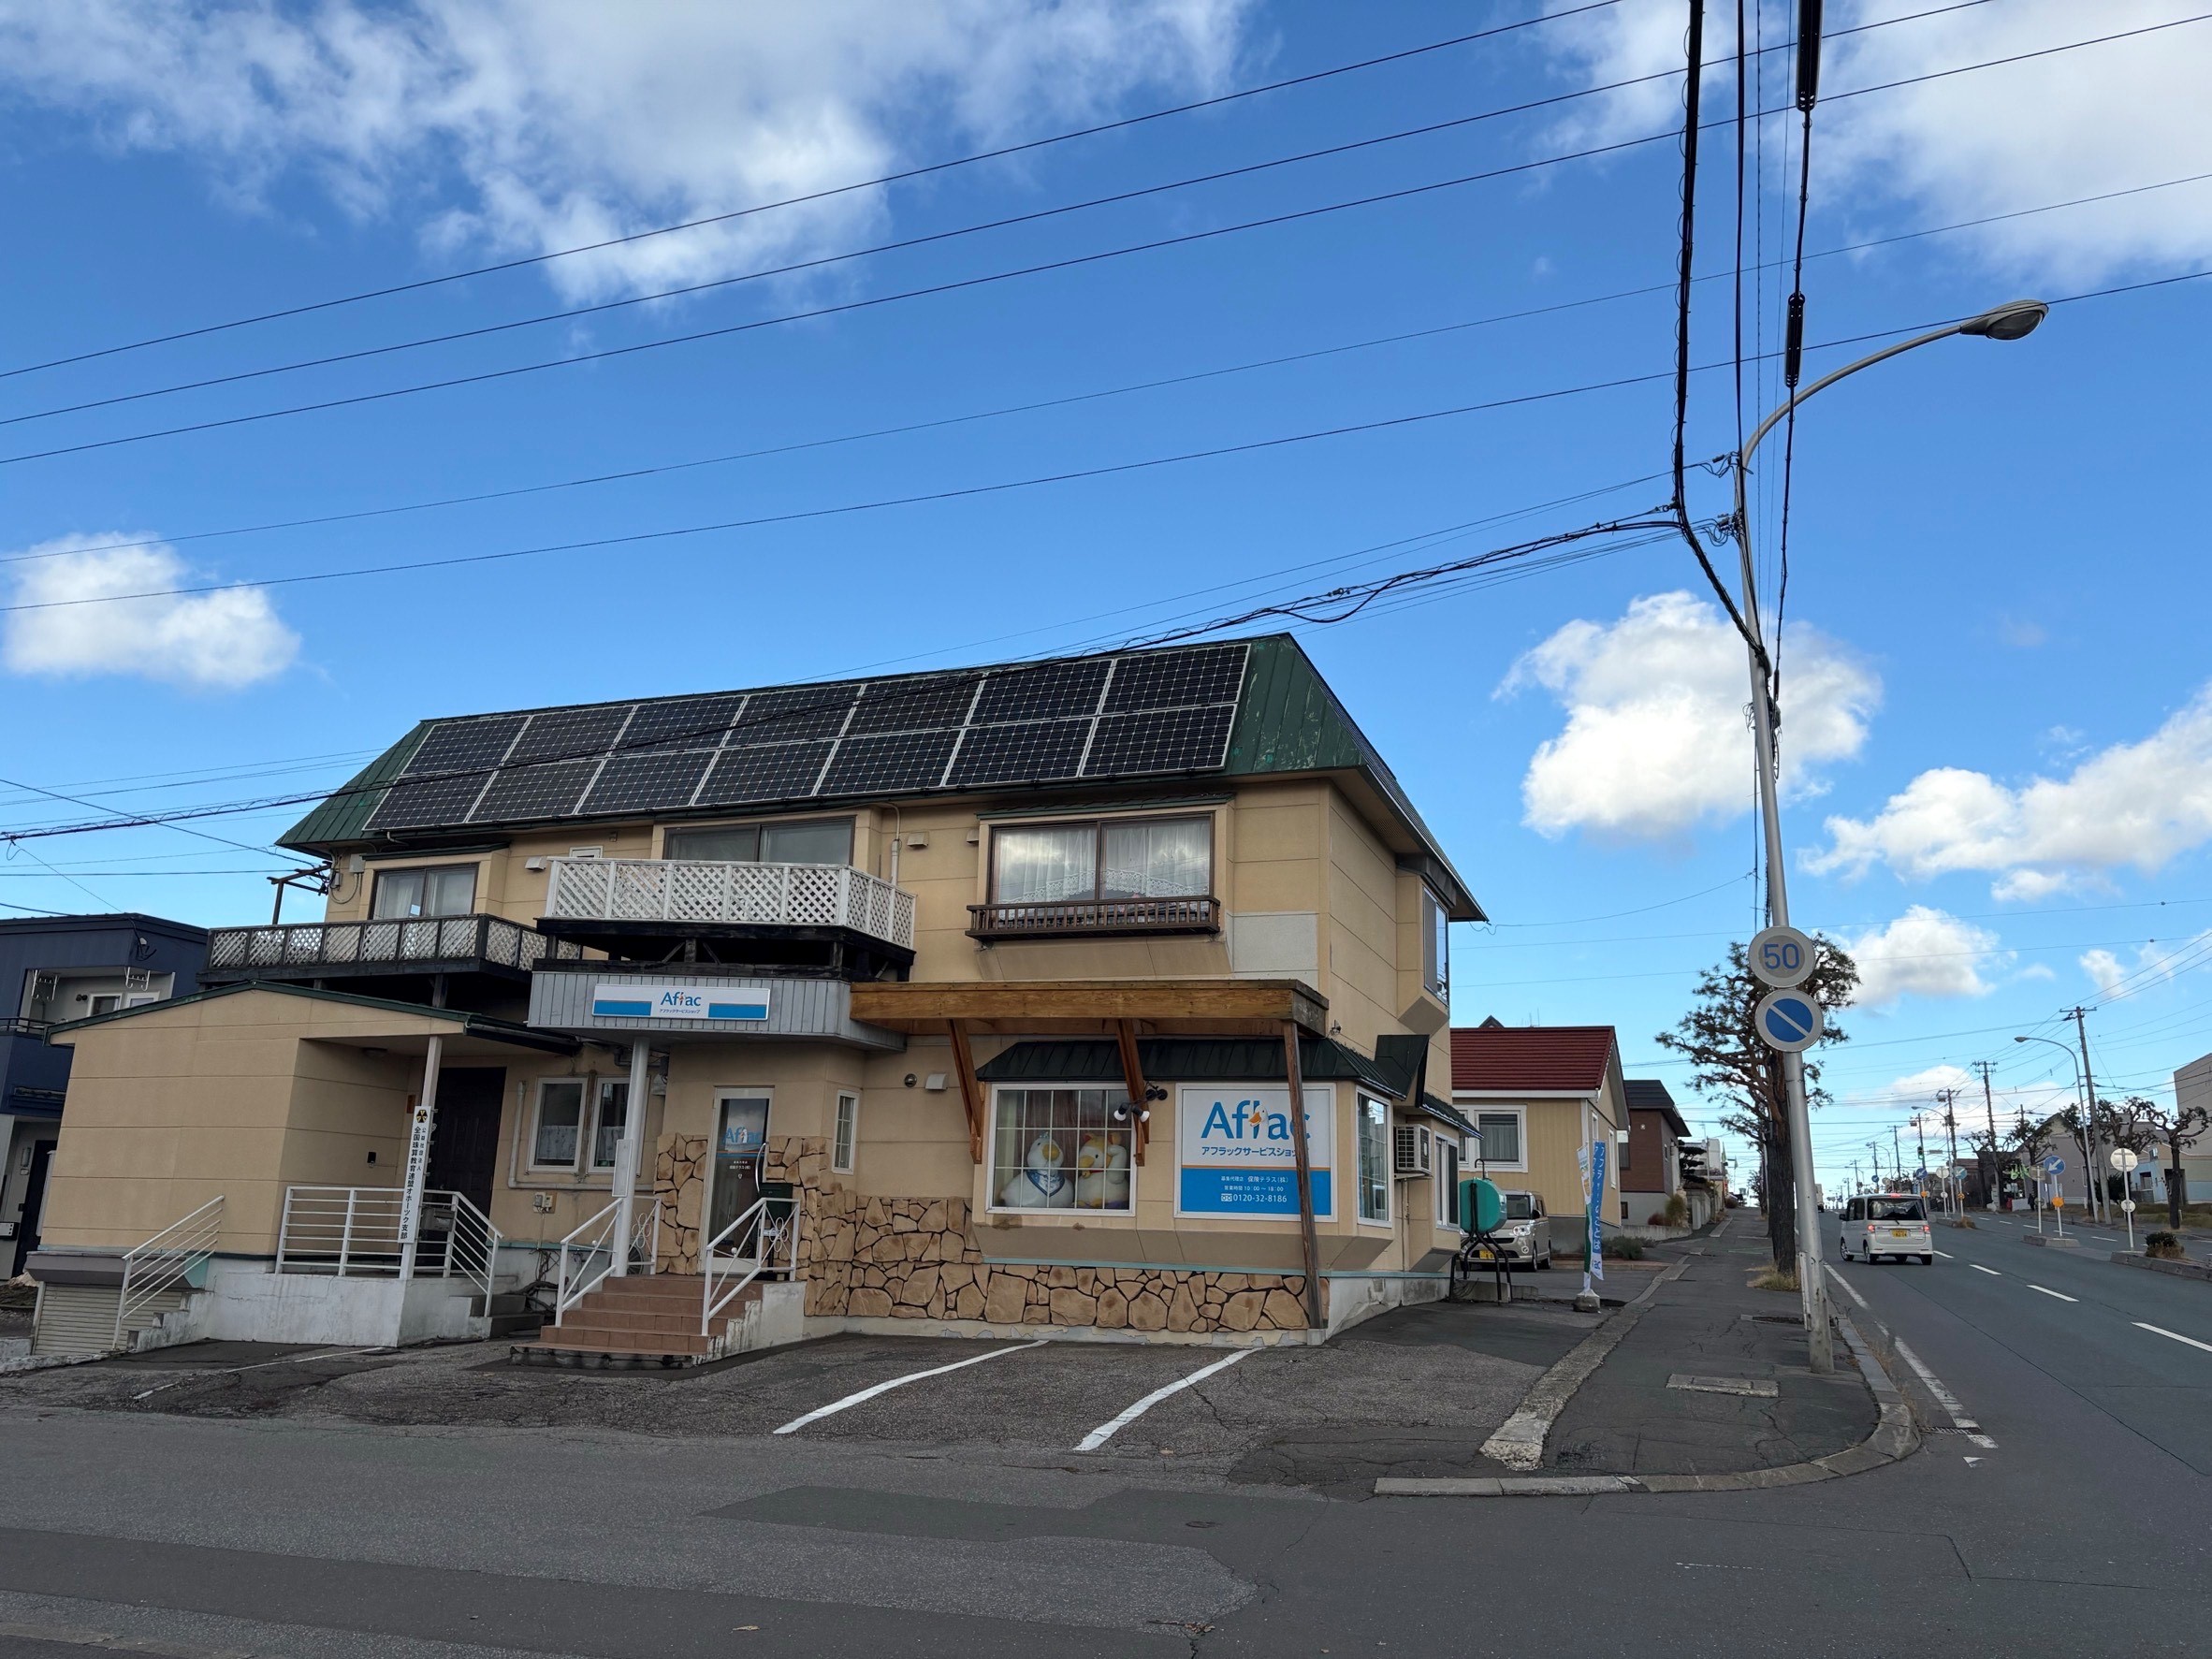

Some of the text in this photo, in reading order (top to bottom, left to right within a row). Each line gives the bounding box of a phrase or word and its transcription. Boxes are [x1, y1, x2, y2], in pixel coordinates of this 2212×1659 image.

[1764, 943, 1799, 969] 50
[660, 992, 702, 1007] Aflac
[1201, 1146, 1297, 1157] アフラックサービスショ
[1232, 1193, 1288, 1202] 0120-32-8186
